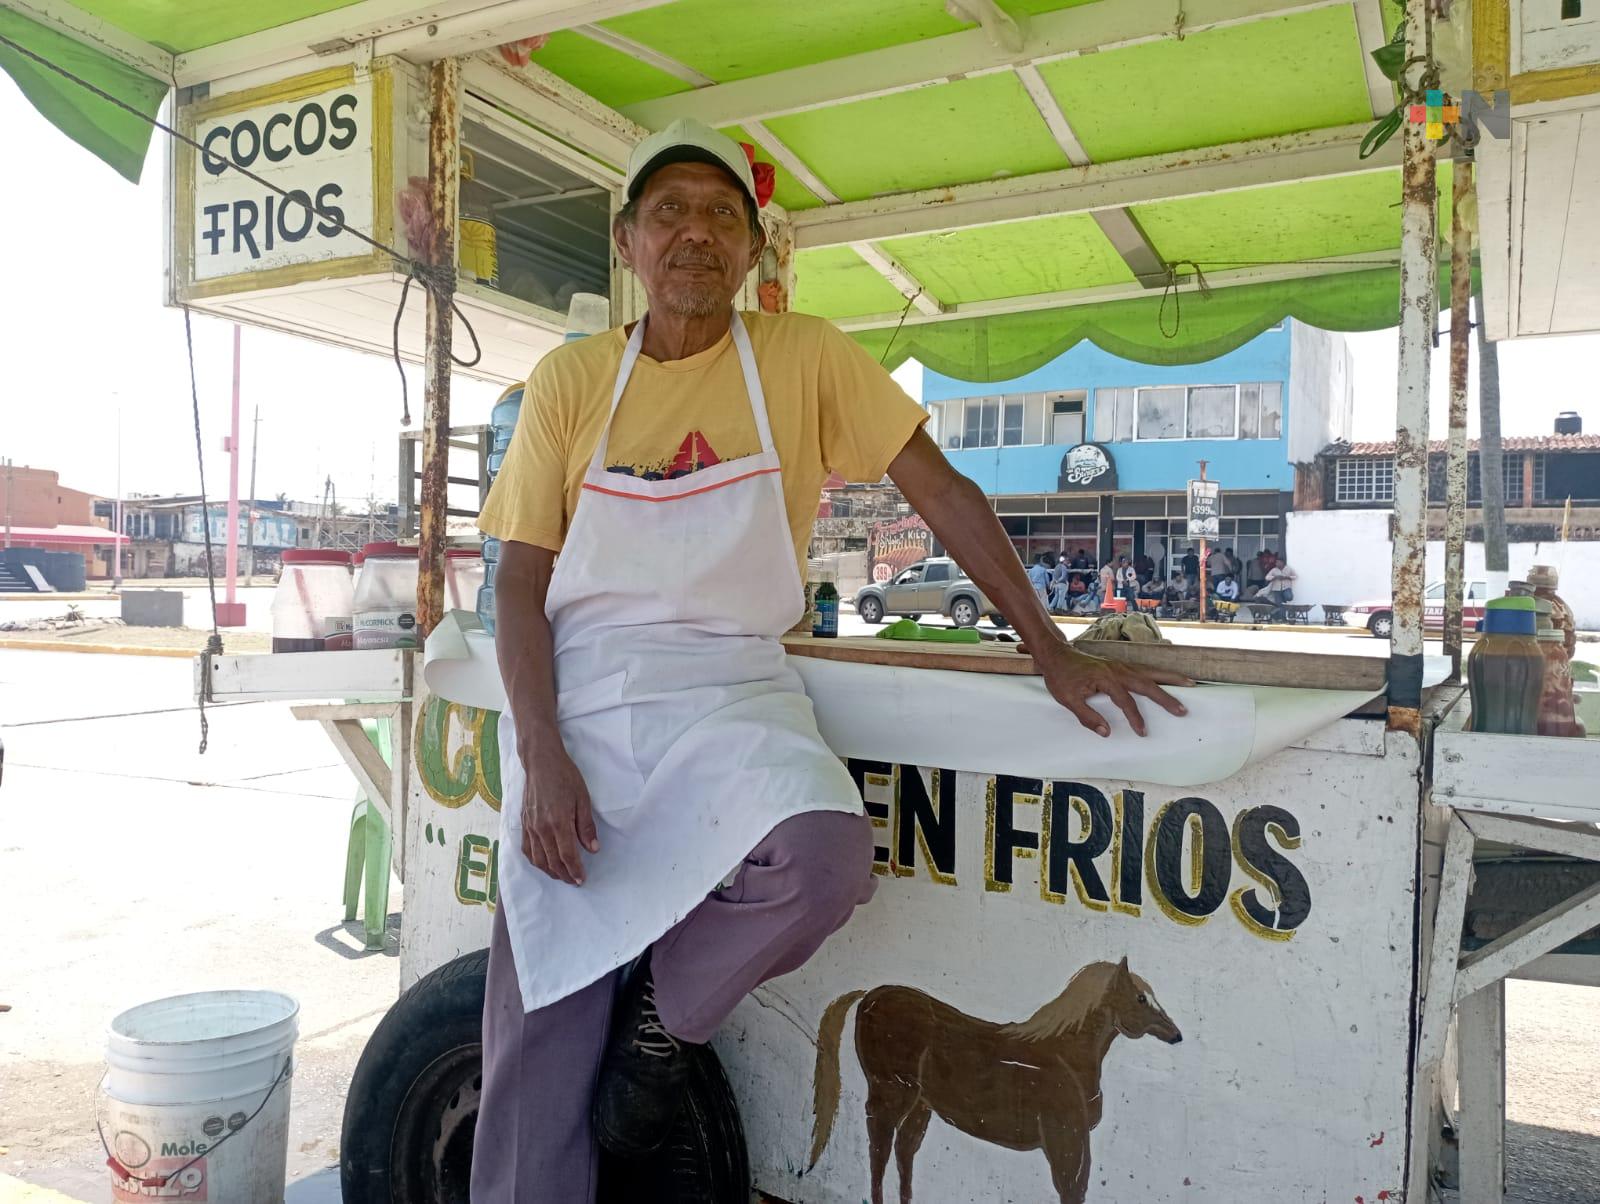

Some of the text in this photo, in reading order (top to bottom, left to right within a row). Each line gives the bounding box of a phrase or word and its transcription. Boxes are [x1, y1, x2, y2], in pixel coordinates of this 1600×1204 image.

[202, 93, 358, 176] COCOS
[202, 183, 345, 259] FRIOS
[1424, 607, 1443, 616] TAXI
[984, 773, 1312, 942] FRIOS
[160, 1140, 208, 1157] Mole
